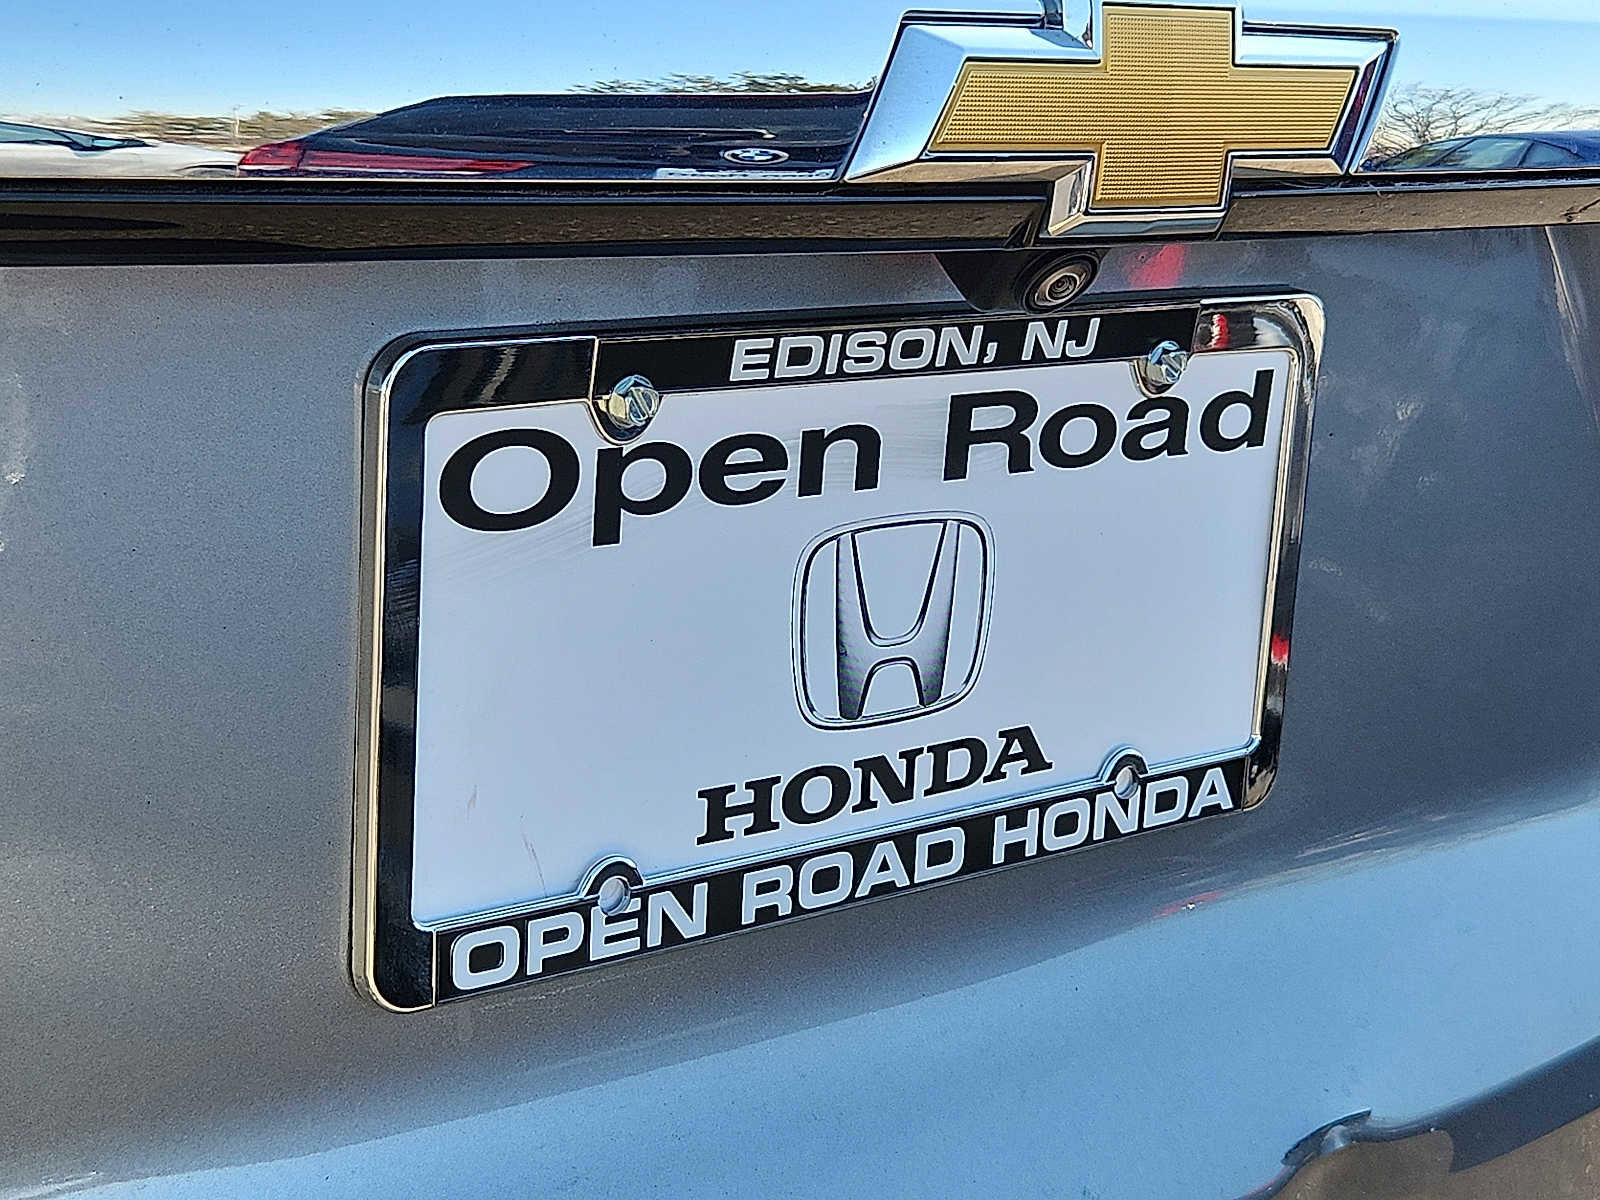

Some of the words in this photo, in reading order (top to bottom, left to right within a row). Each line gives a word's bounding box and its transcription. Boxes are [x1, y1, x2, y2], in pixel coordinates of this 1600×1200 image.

[729, 325, 997, 382] EDISON,
[1021, 317, 1101, 361] NJ
[439, 424, 881, 547] Open
[943, 370, 1273, 483] Road
[696, 725, 1052, 846] HONDA
[452, 882, 708, 991] OPEN
[741, 827, 965, 925] ROAD
[992, 766, 1234, 864] HONDA
